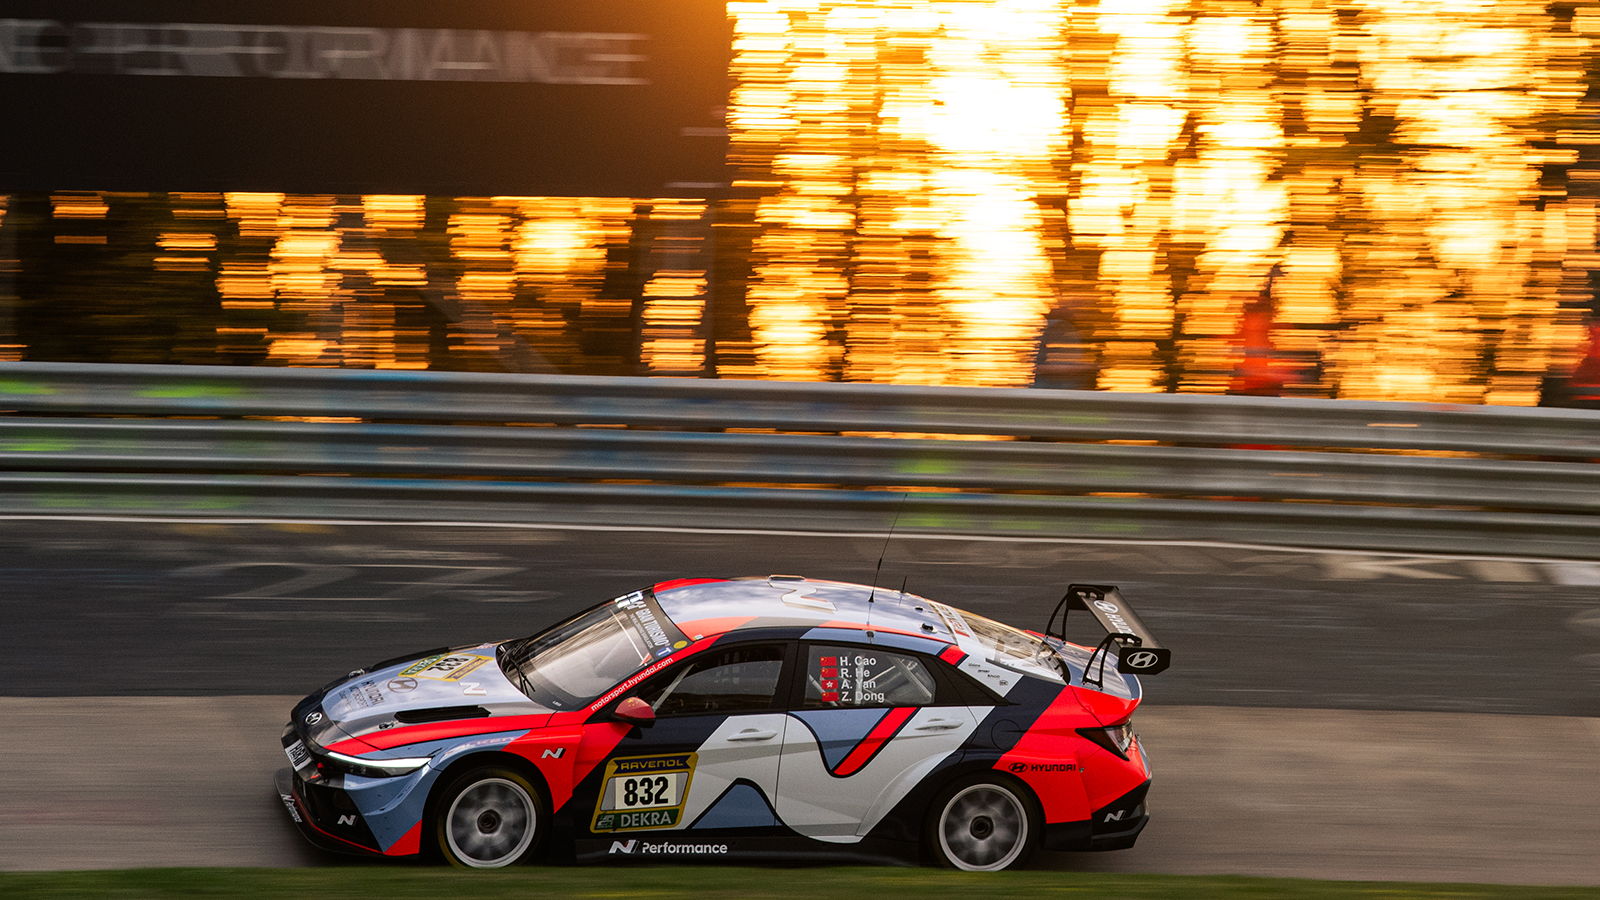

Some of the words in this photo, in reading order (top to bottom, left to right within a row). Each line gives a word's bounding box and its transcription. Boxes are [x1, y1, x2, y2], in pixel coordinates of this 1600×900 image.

[427, 657, 470, 672] 832
[840, 656, 852, 667] H.
[854, 655, 877, 667] Cao
[840, 668, 853, 679] R.
[855, 667, 871, 678] He
[590, 657, 673, 712] motorsport.hyundai.com
[841, 679, 853, 690] A.
[855, 678, 877, 689] Yan
[841, 691, 853, 702] Z.
[855, 690, 885, 703] Dong
[620, 759, 684, 771] RAVENOL
[1030, 763, 1077, 772] HYUNDAI
[623, 776, 669, 807] 832
[620, 811, 672, 828] DEKRA
[608, 839, 640, 855] N
[641, 841, 728, 854] Performance
